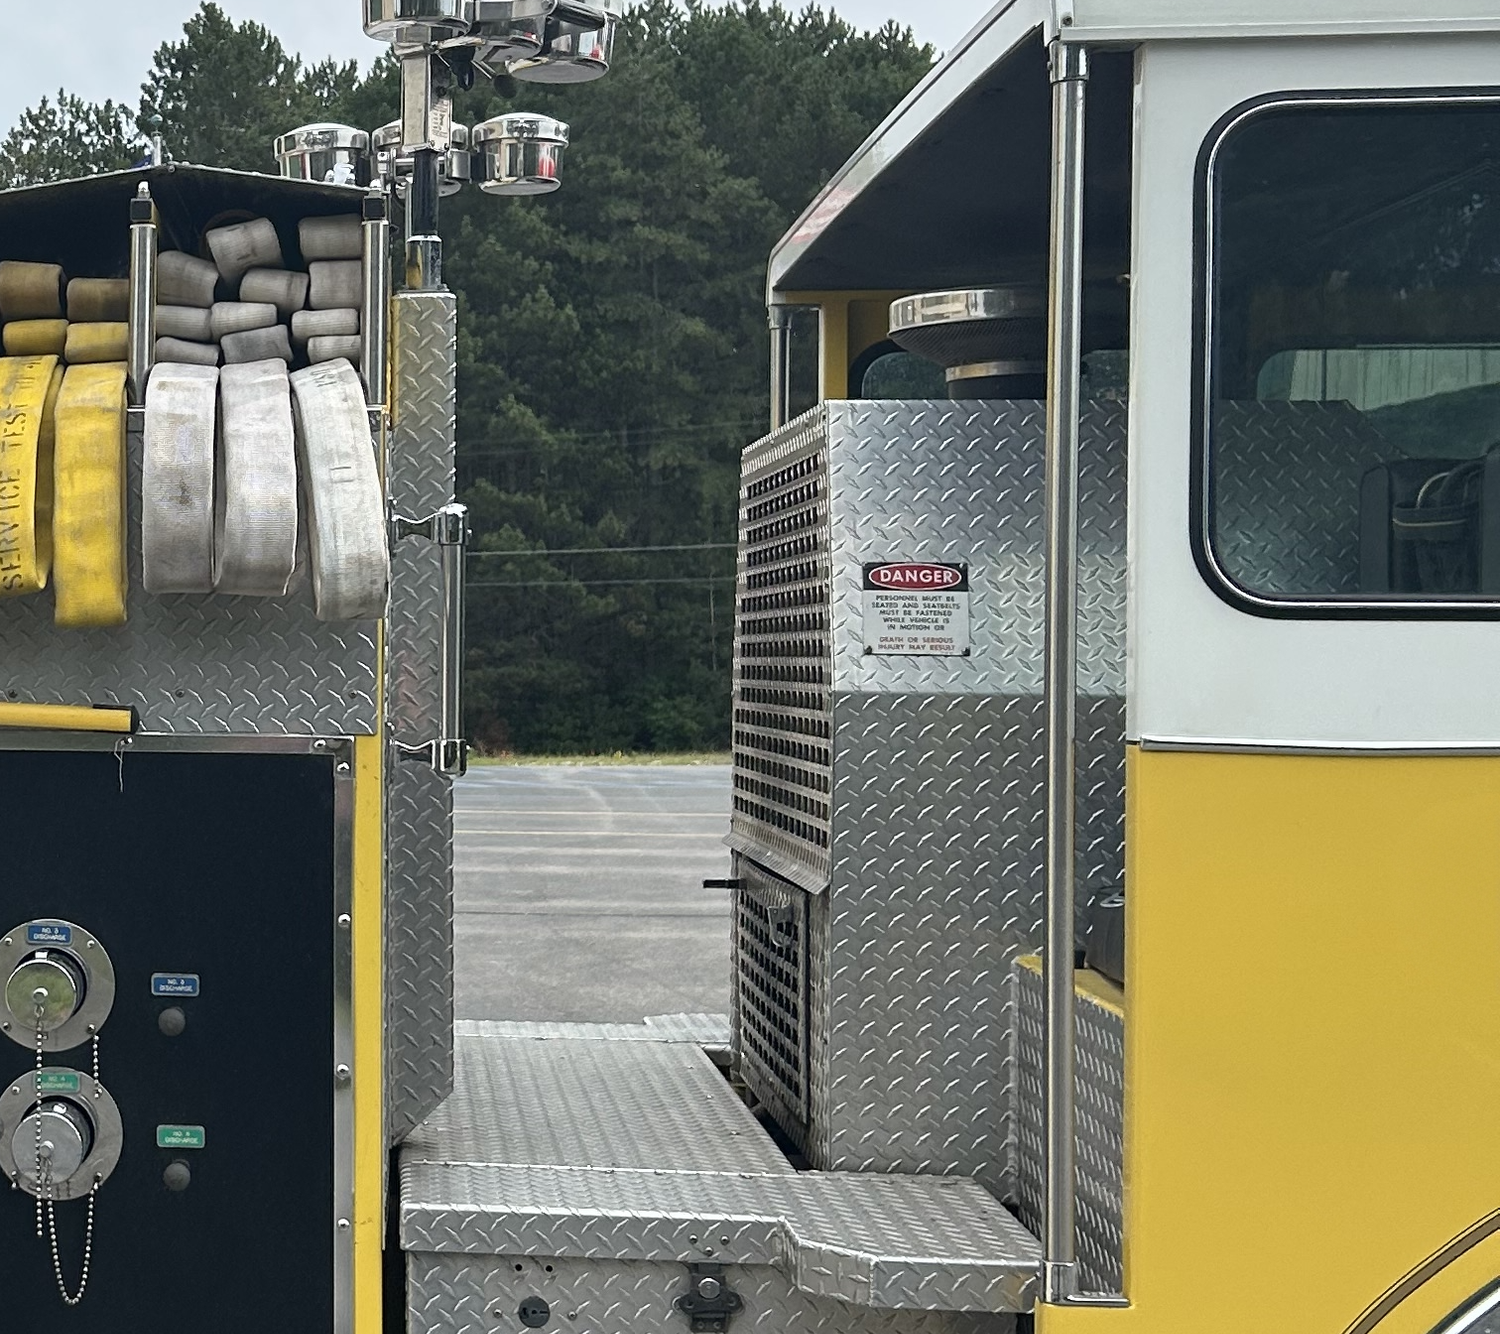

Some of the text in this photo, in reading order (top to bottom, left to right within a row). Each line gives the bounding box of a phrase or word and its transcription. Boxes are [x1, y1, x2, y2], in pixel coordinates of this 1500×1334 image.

[2, 403, 28, 454] TEST
[880, 569, 953, 583] DANGER
[922, 602, 961, 610] SEATBELTS
[33, 933, 67, 941] DISCHARGE
[159, 984, 193, 992] DISCHARGE
[164, 1136, 198, 1144] DISCHARGE
